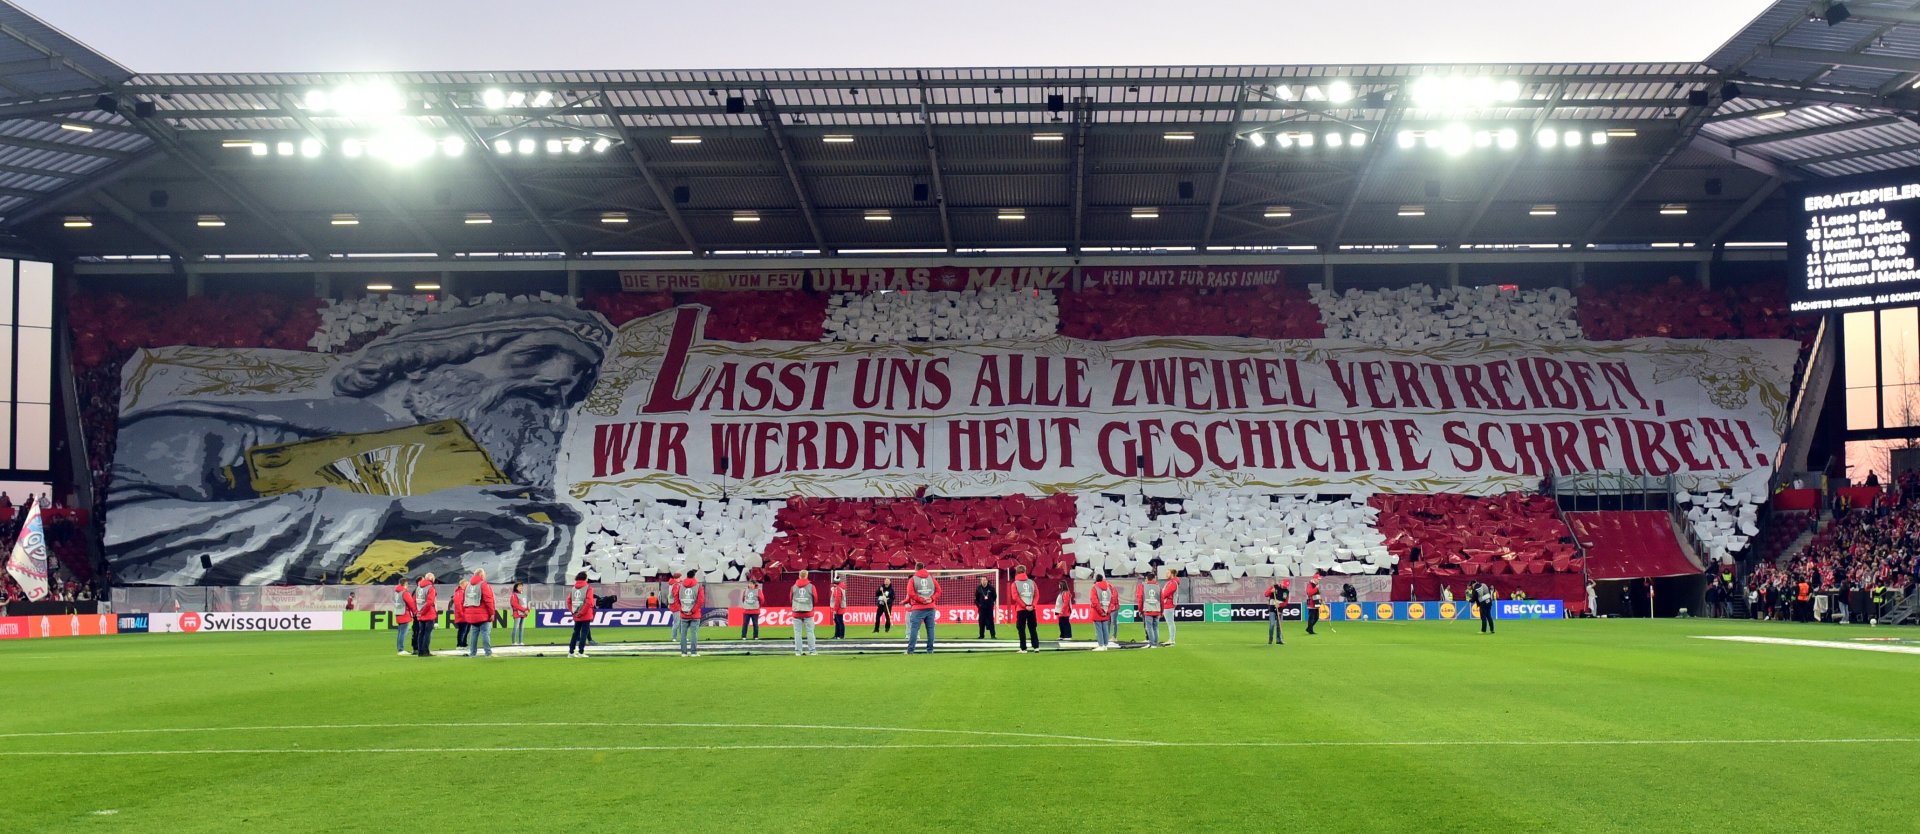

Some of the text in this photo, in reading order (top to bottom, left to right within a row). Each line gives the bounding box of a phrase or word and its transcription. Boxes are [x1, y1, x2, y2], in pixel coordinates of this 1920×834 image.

[1805, 184, 1920, 211] ERSATZSPIELER
[1812, 216, 1819, 228] 1
[1824, 225, 1856, 238] Louis
[1858, 220, 1902, 235] Babatz
[1822, 237, 1862, 251] Maxim
[1807, 244, 1906, 265] 11 Armindo Sieb
[1807, 265, 1822, 277] 14
[1824, 262, 1869, 276] William
[623, 274, 800, 288] DIE FANS VOM FSV
[811, 267, 1071, 291] ULTRAS MAINZ
[1103, 270, 1133, 286] KEIN
[1138, 270, 1175, 286] PLATZ
[1825, 272, 1875, 288] Lennard
[1875, 294, 1889, 304] AM
[642, 307, 1666, 417] LASST UNS ALLE ZWEIFEL VERTREIBEN,
[592, 416, 1770, 479] WIR WERDEN HEUT GESCHICHTE SCHREIBEN!
[949, 609, 1014, 621] STRASS
[1217, 606, 1300, 619] enterpse
[1503, 603, 1556, 614] RECYCLE
[203, 613, 312, 632] Swissquote
[754, 608, 824, 626] Betao
